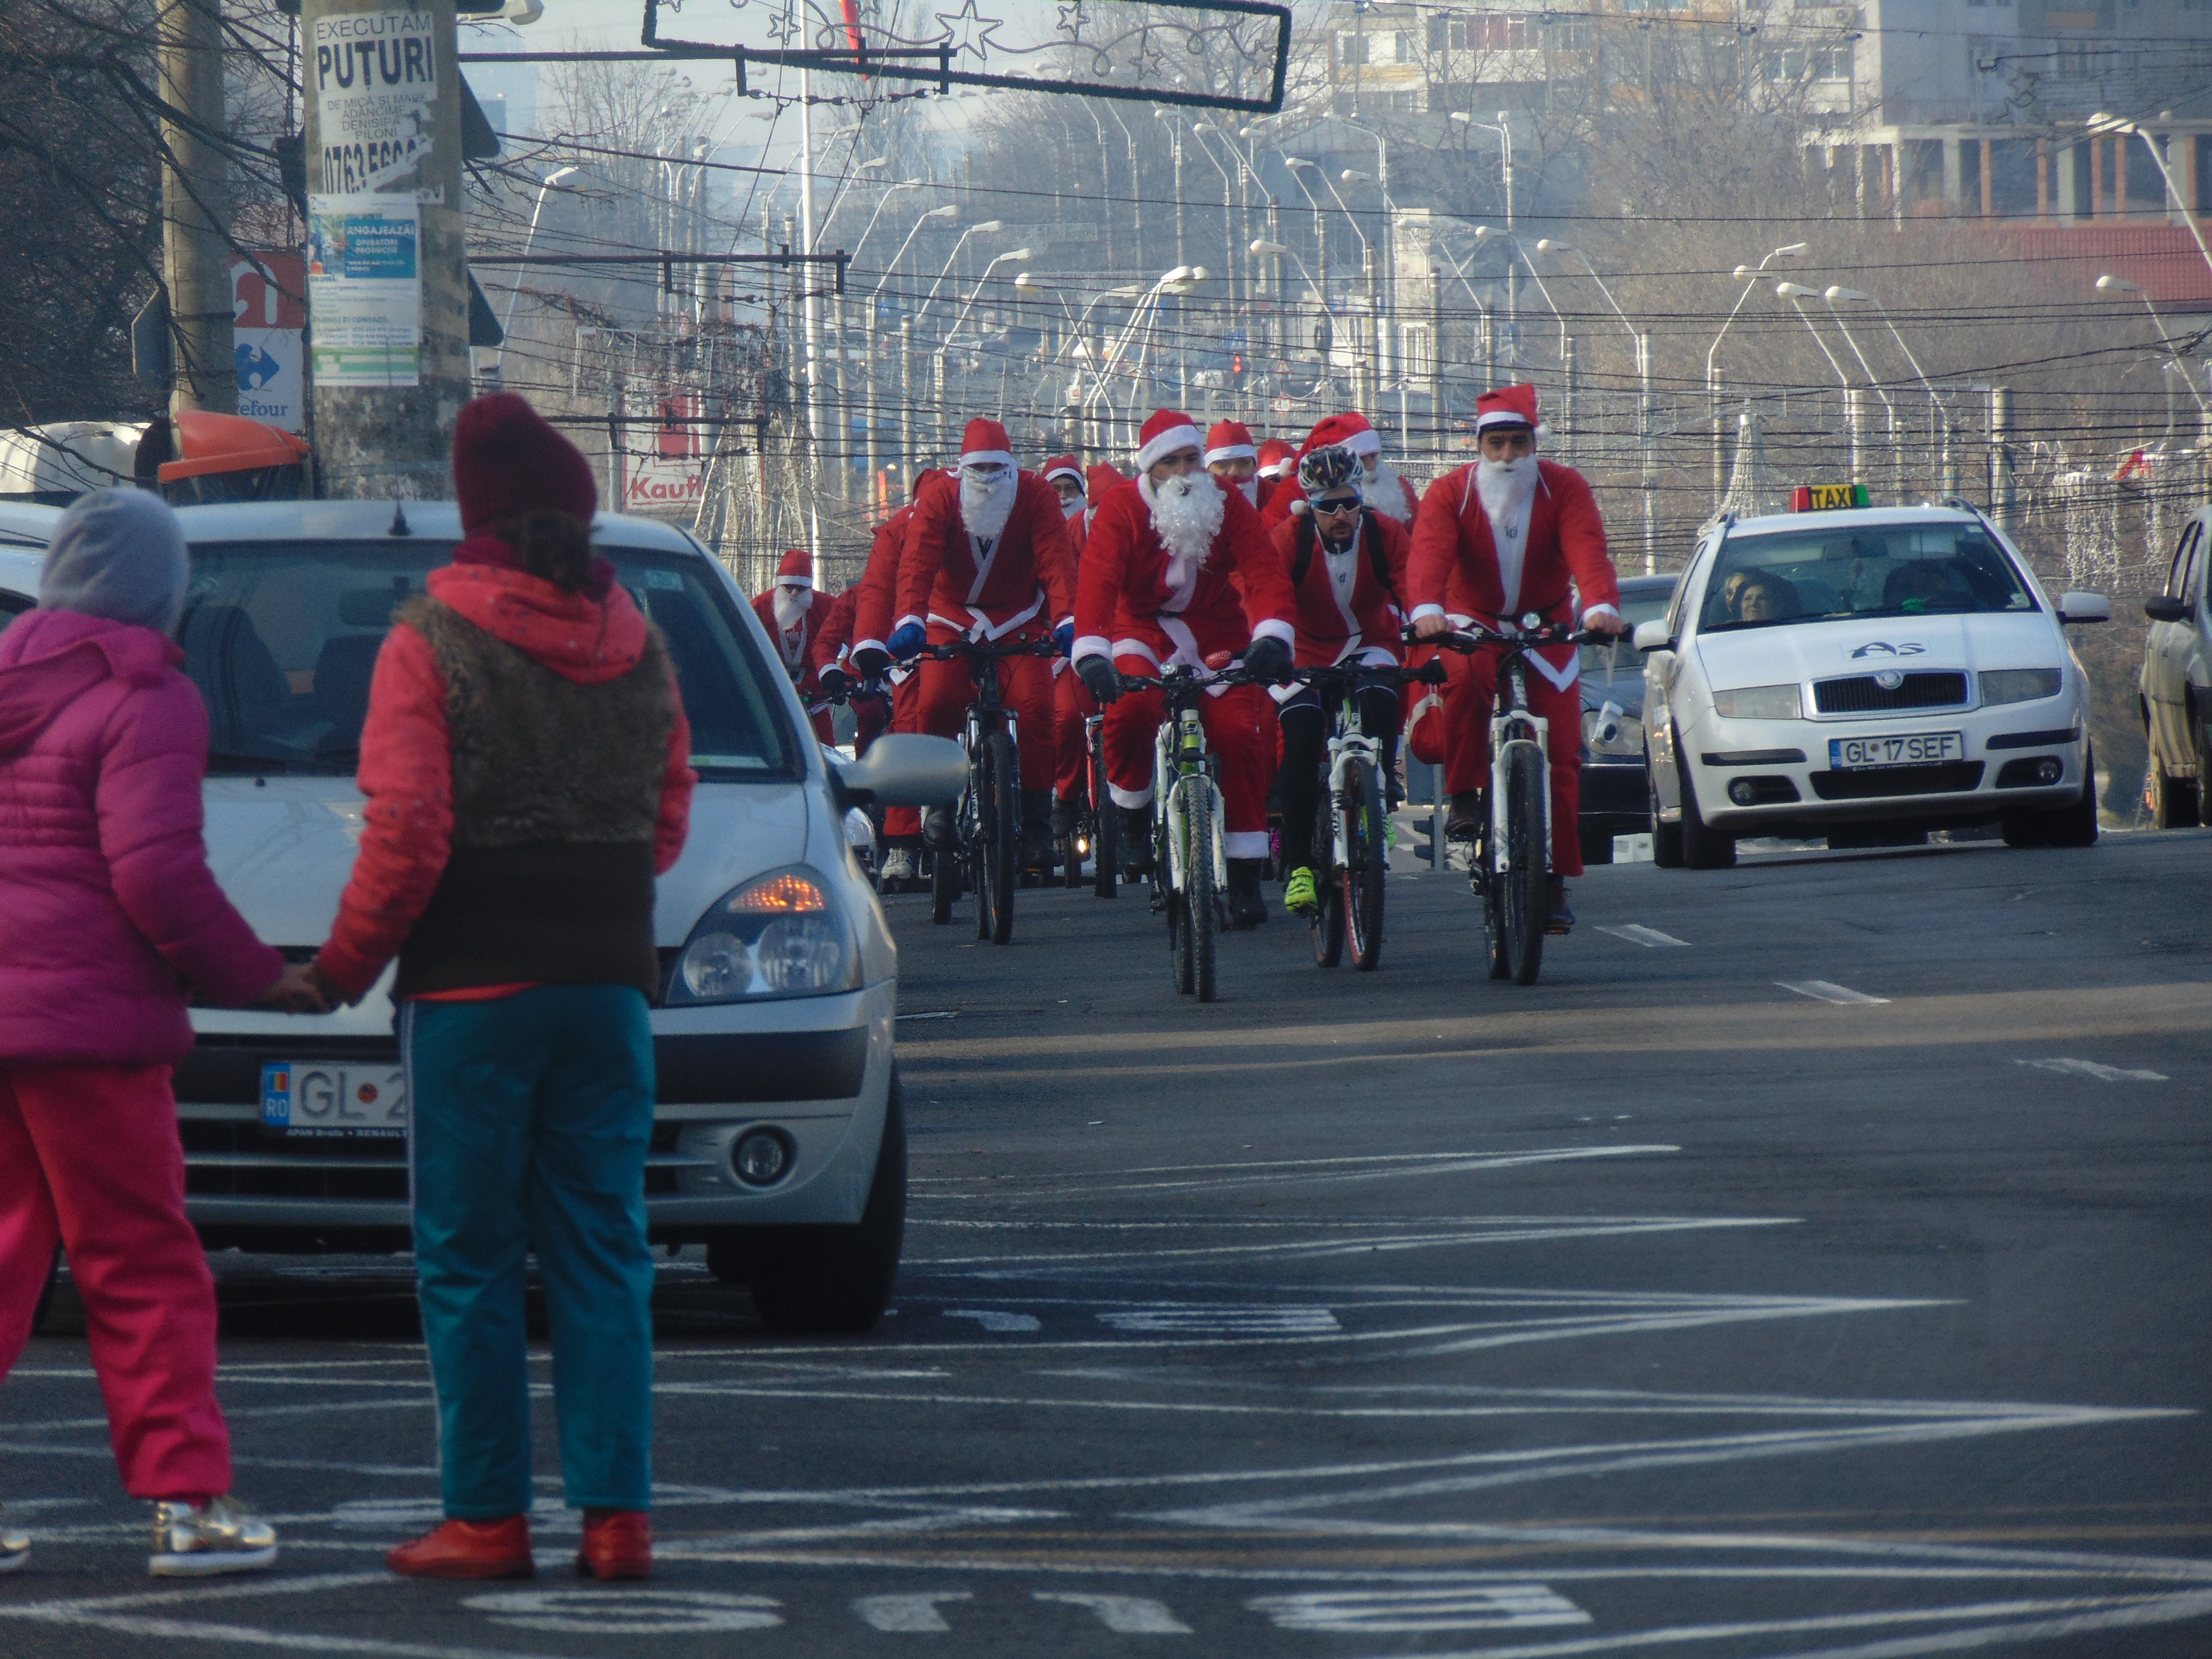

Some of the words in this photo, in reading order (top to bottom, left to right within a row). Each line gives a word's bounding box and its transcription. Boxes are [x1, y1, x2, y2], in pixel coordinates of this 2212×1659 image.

[328, 100, 340, 110] DE
[355, 128, 398, 140] PILONI
[1811, 487, 1853, 510] TAXI
[1846, 742, 1875, 763] GL
[1884, 739, 1904, 761] 17
[1908, 737, 1954, 759] SEF
[300, 1071, 366, 1120] GL
[267, 1098, 289, 1117] RO
